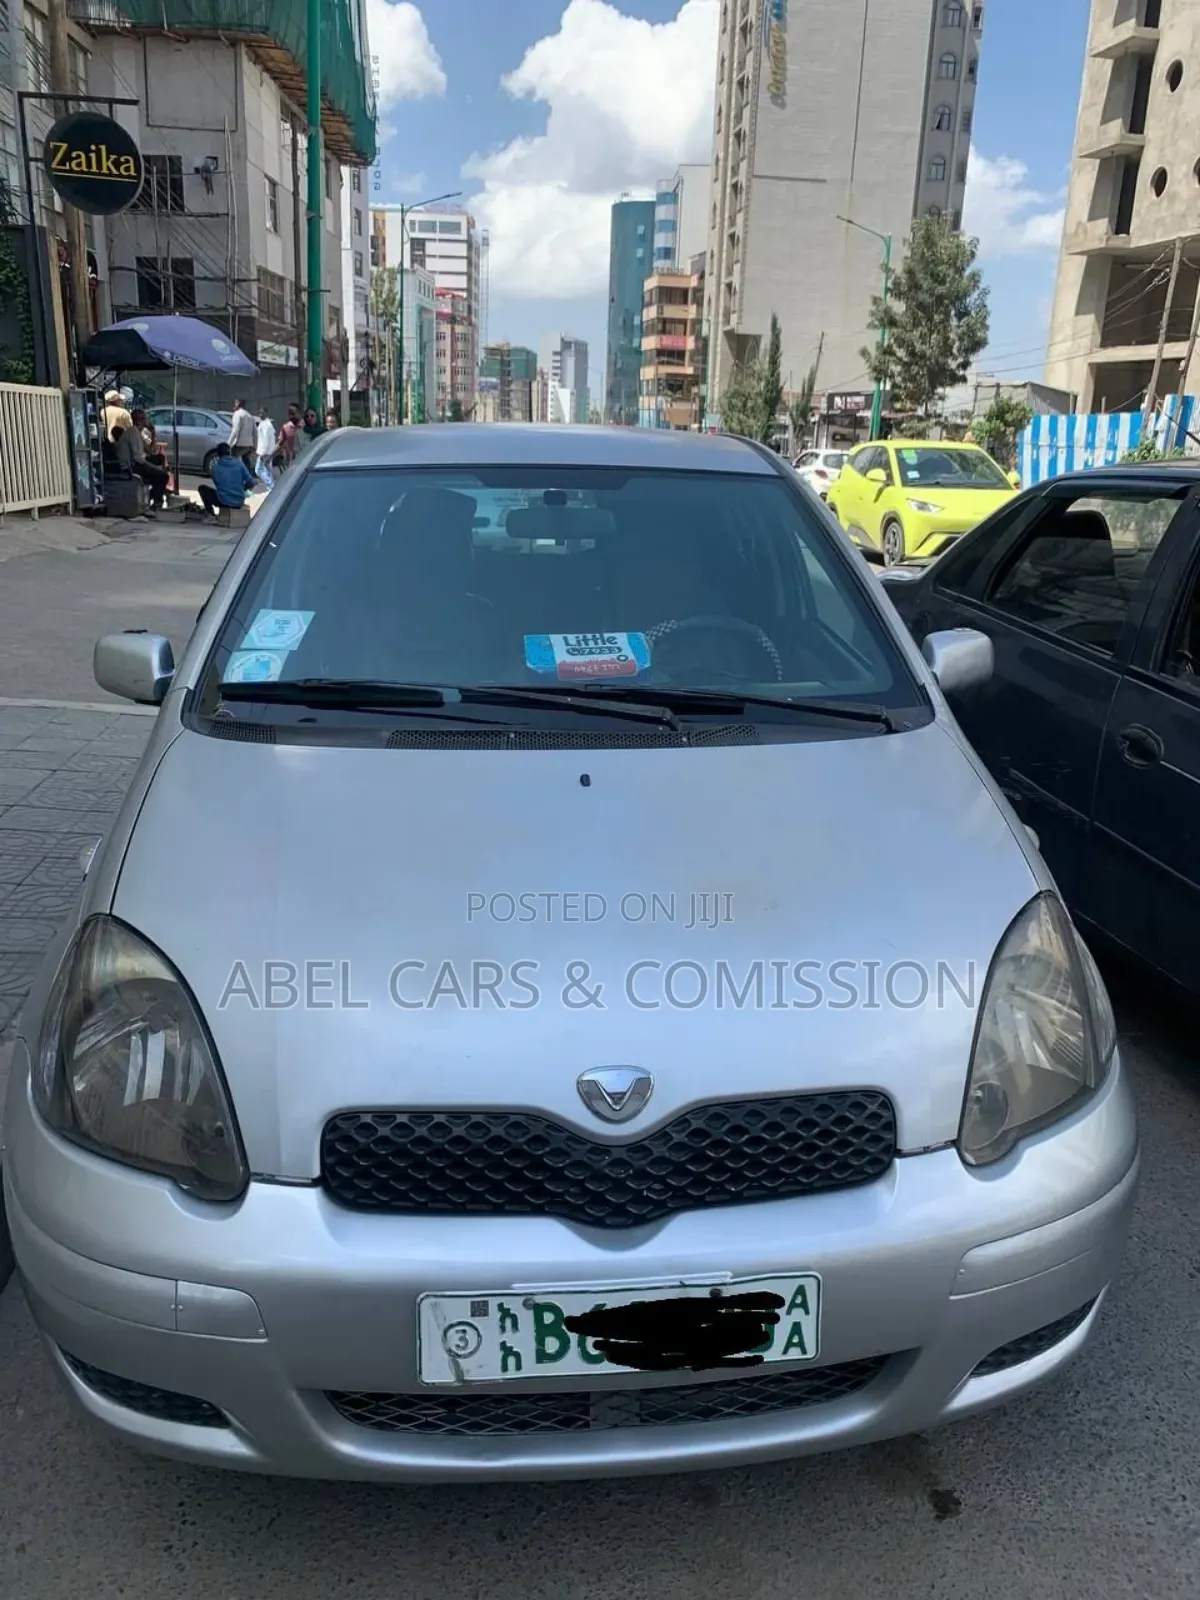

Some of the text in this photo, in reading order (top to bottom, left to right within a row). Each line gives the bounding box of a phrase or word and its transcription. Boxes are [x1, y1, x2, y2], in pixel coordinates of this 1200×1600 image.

[49, 141, 138, 177] Zaika
[562, 633, 618, 647] Little
[454, 1328, 470, 1352] 3
